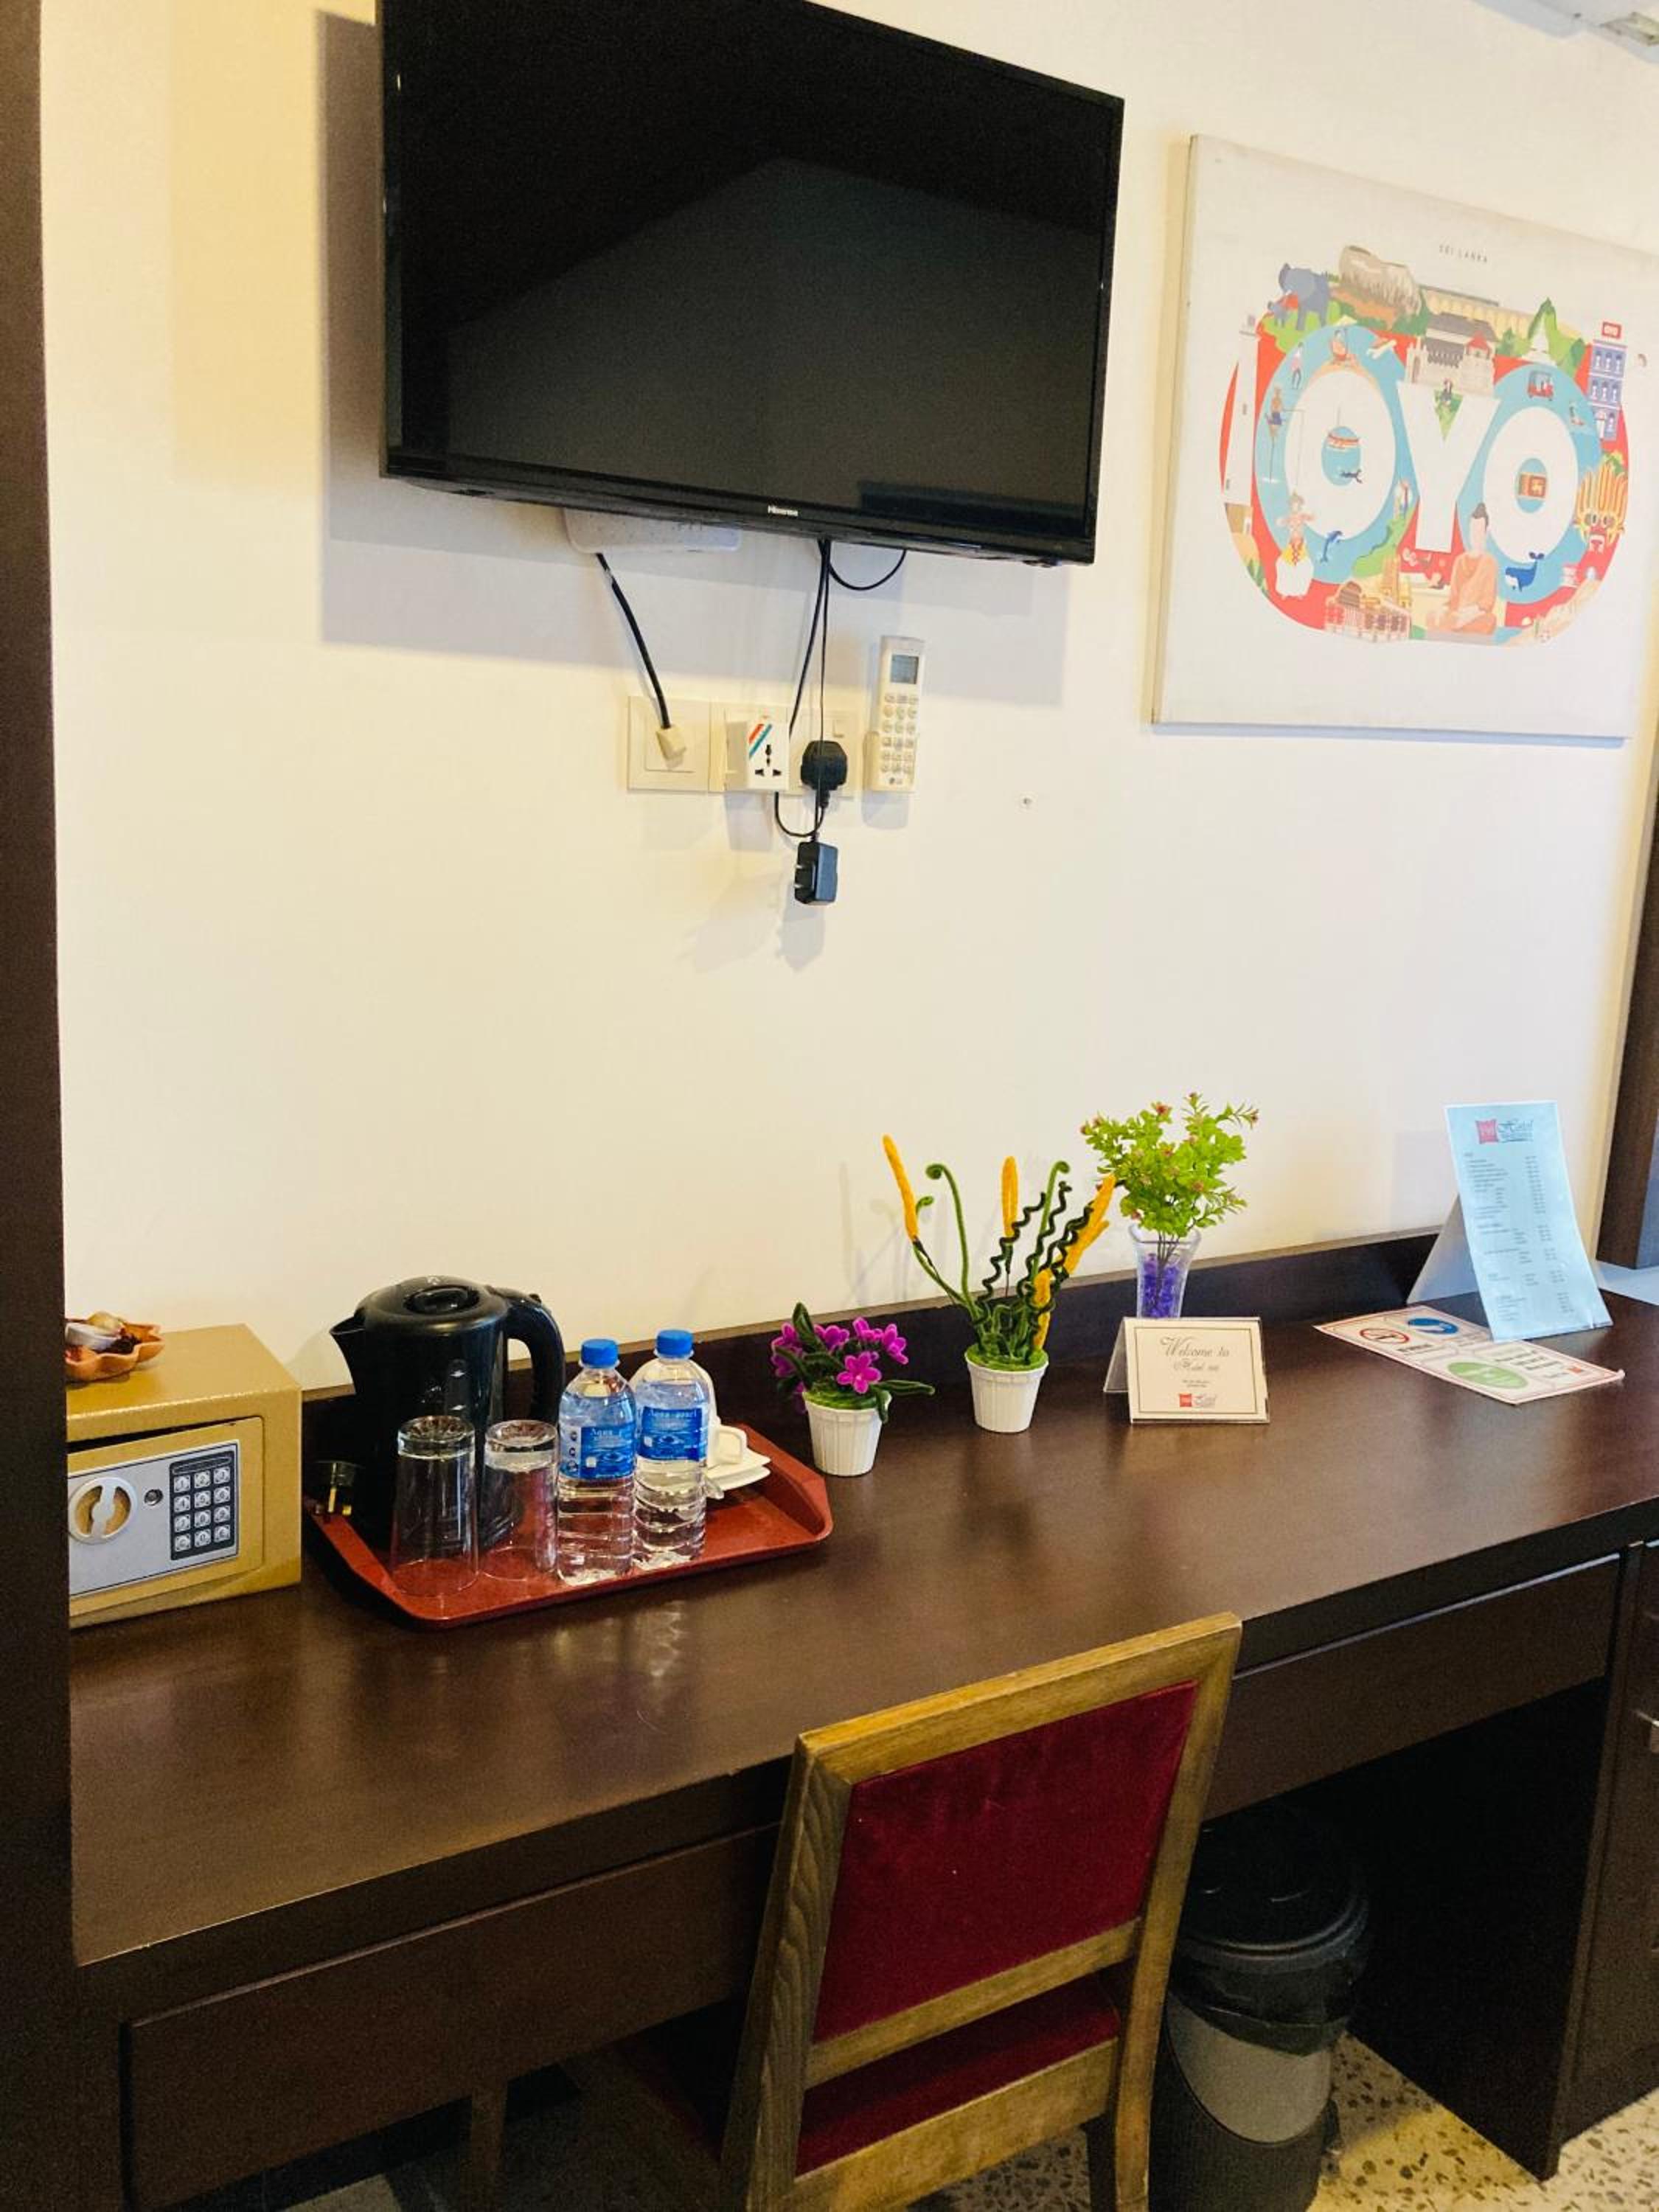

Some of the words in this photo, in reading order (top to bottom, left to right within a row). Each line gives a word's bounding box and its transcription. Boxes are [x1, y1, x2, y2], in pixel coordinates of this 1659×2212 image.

[1284, 371, 1579, 564] OYO
[1159, 1335, 1213, 1357] Welcome
[1217, 1346, 1230, 1357] to
